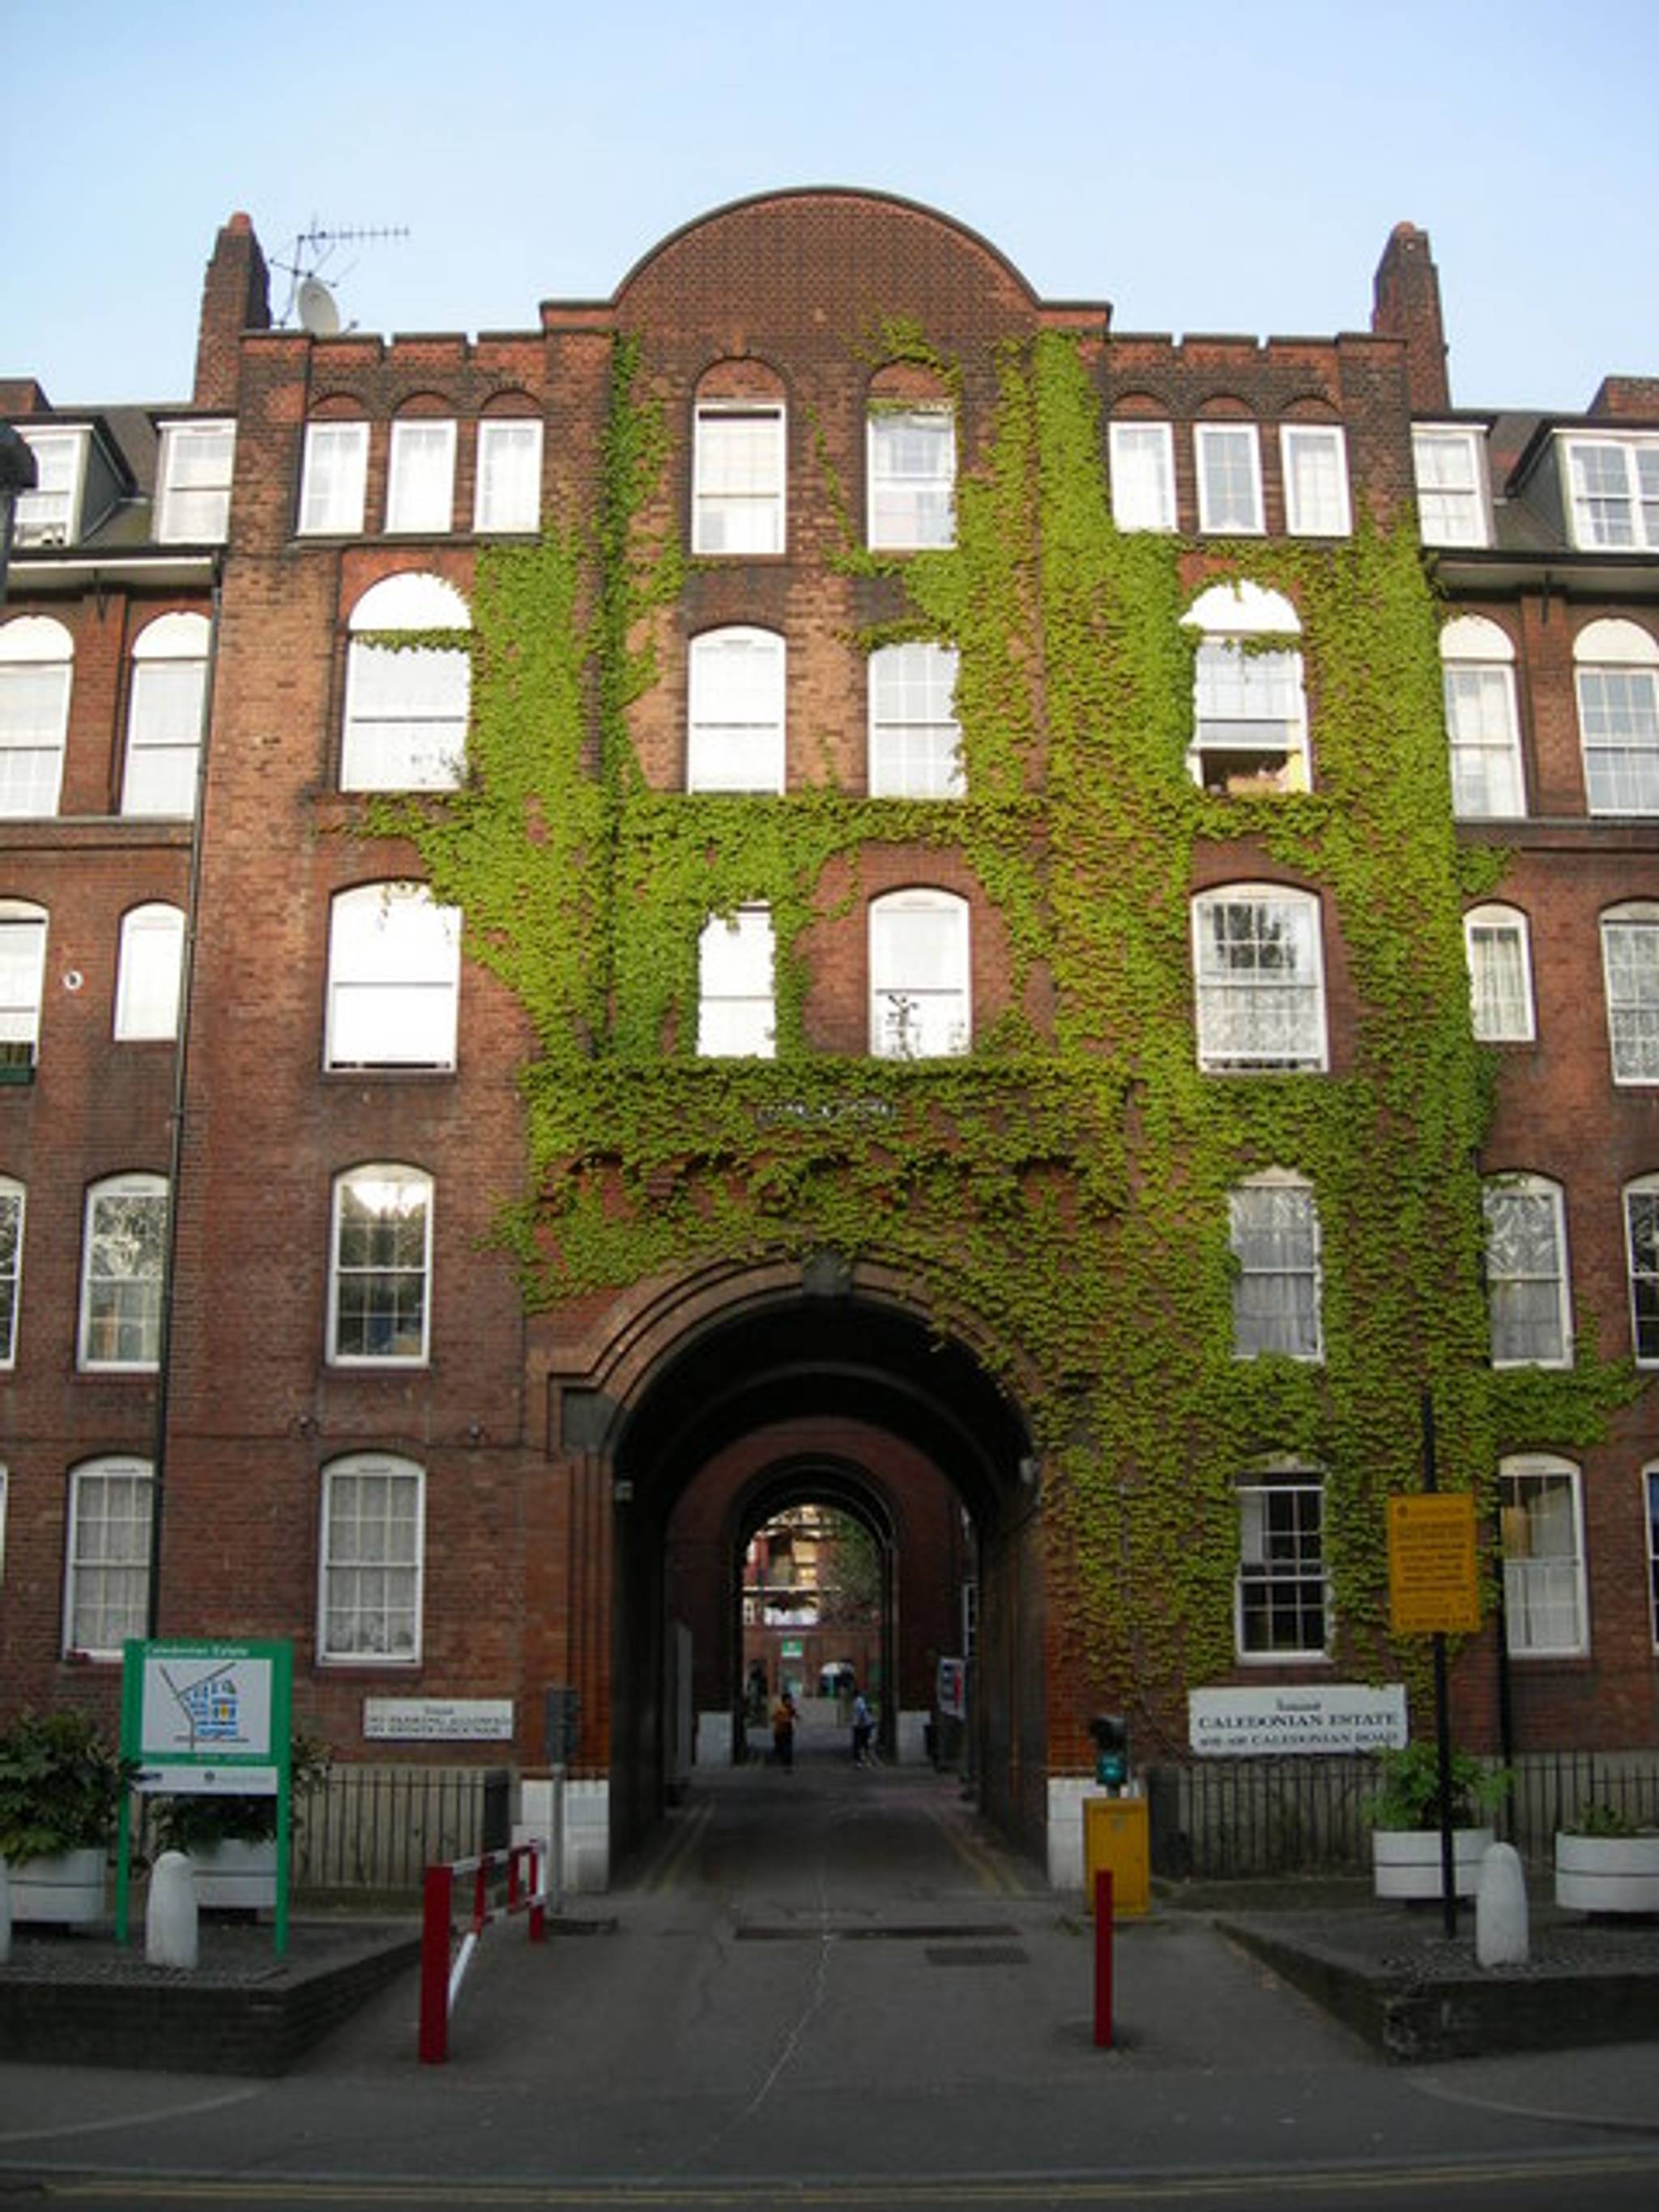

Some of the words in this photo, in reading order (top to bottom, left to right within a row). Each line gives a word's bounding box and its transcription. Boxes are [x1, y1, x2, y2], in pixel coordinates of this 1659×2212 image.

[1198, 1715, 1323, 1729] CALEDONIAN
[1328, 1713, 1397, 1726] ESTATE
[1251, 1733, 1350, 1745] CALEDONIAN
